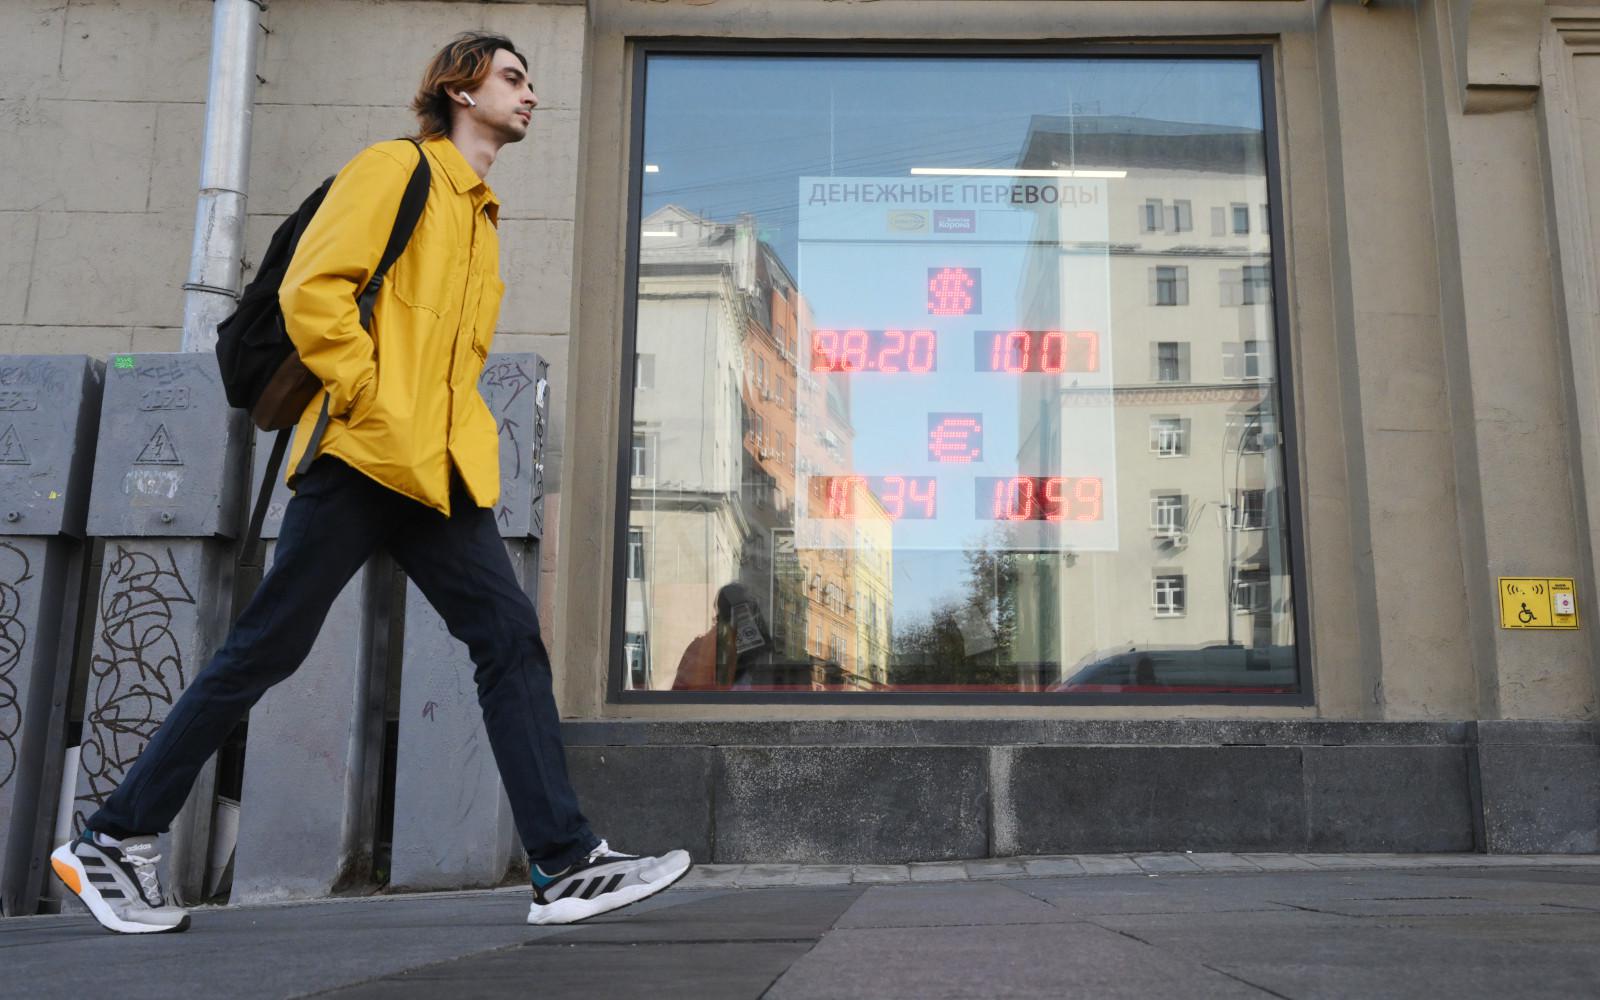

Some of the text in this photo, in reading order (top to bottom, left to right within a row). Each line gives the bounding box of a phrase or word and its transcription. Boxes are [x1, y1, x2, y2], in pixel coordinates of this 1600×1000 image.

[808, 183, 1099, 208] ДЕНЕЖНЫЕ ПЕРЕВОДЫ
[928, 417, 981, 464] €
[126, 843, 152, 852] adidas
